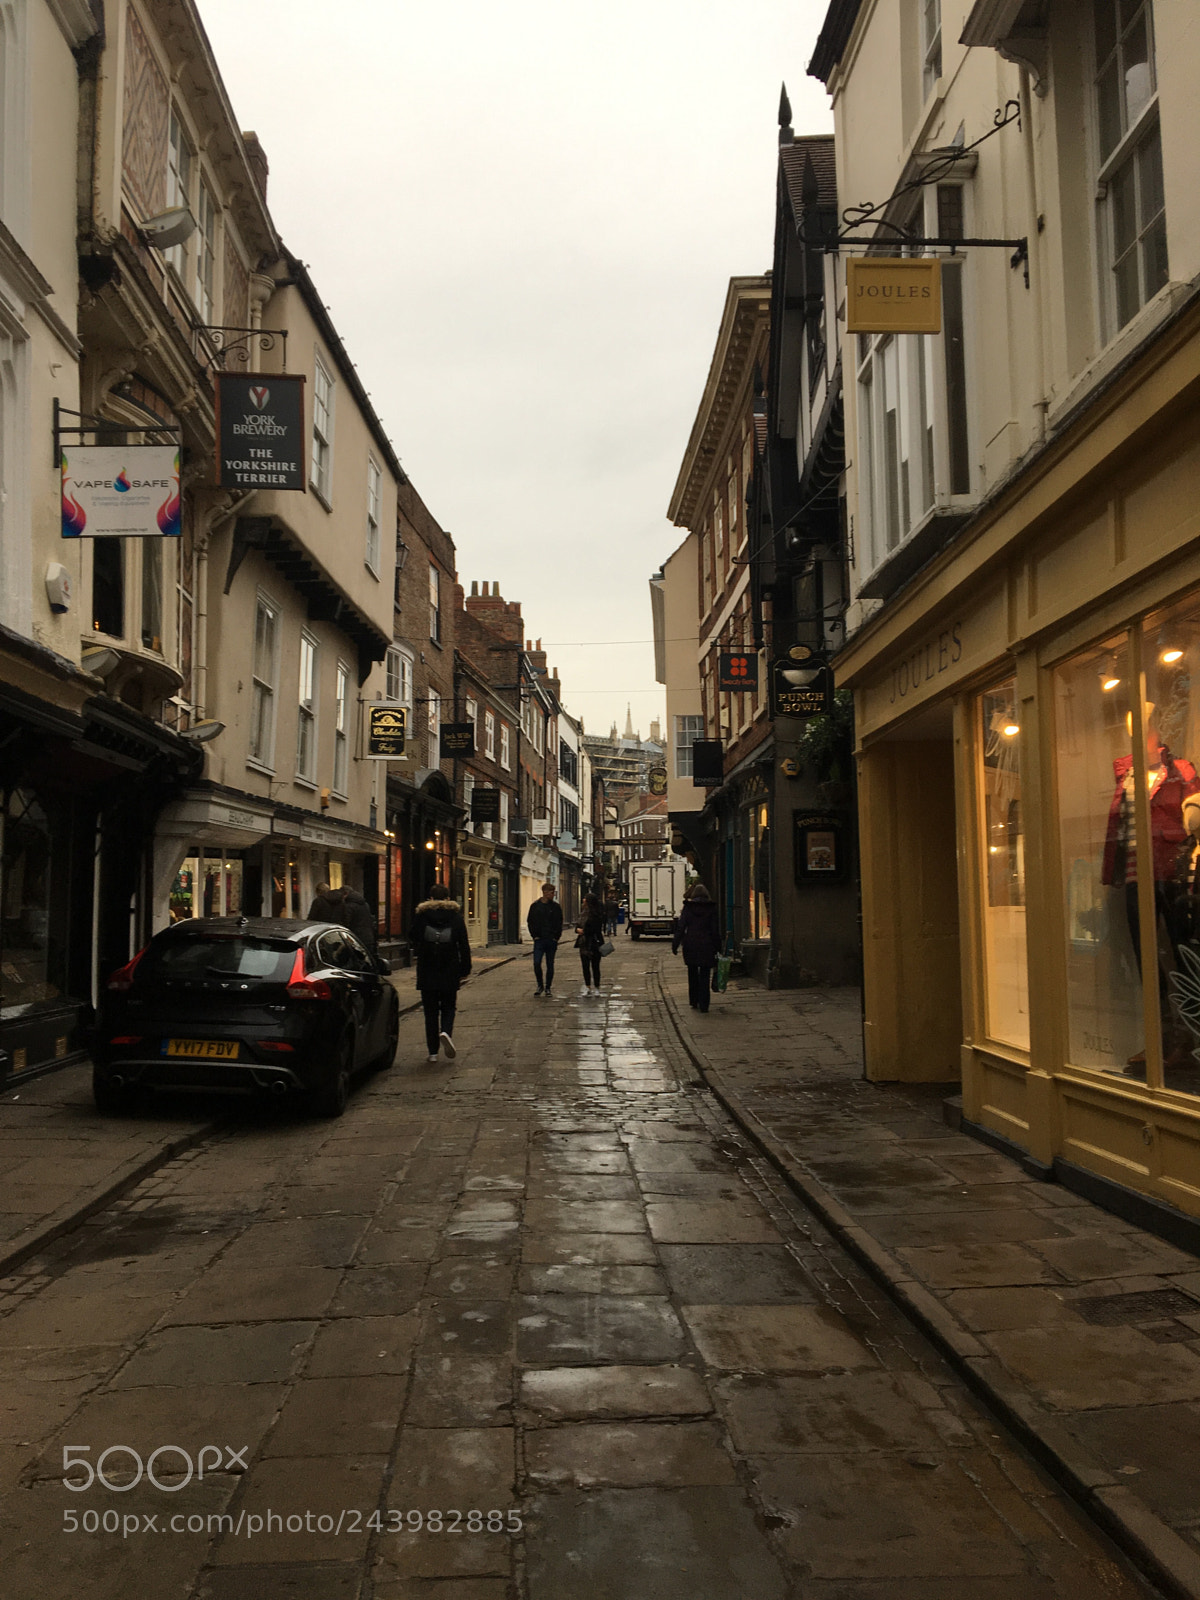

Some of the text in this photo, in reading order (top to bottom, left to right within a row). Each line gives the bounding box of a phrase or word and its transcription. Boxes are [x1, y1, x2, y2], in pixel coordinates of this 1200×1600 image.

[857, 285, 931, 298] JOULES
[243, 414, 276, 426] YORK
[232, 424, 288, 436] BREWERY
[249, 448, 274, 458] THE
[225, 460, 297, 472] YORKSHIRE
[73, 479, 169, 489] VAPE SAFE
[235, 473, 287, 484] TERRIER
[889, 621, 962, 704] JOULES
[777, 692, 824, 702] PUNCH
[782, 702, 822, 712] BOWL
[173, 1041, 235, 1056] YY17 FDV
